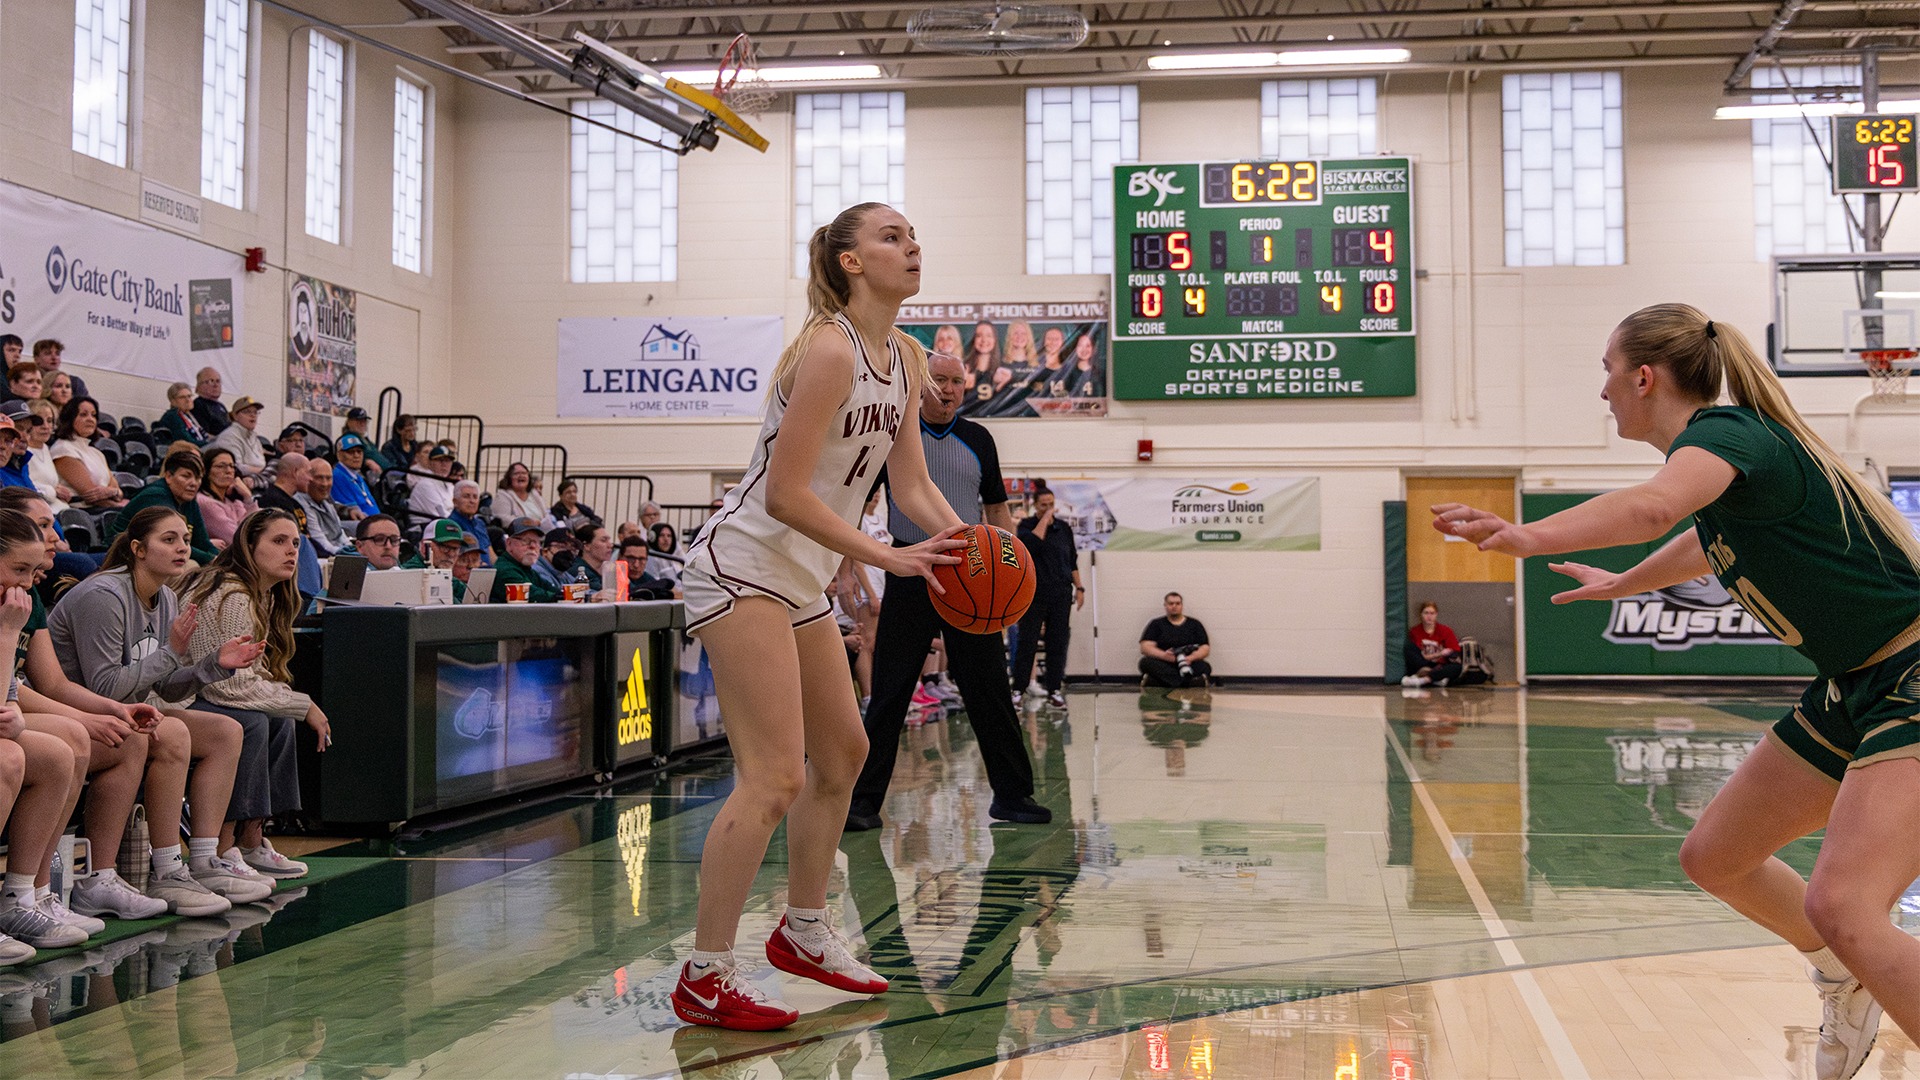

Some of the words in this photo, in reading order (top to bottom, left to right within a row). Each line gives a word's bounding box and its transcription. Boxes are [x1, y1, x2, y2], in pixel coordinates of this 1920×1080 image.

[1855, 119, 1913, 144] 6:22
[1867, 144, 1904, 186] 15
[1231, 163, 1316, 201] 6:22
[1323, 171, 1406, 184] BISMARCK
[145, 191, 174, 216] RESERVED
[175, 202, 199, 224] SEATING
[1333, 205, 1390, 223] GUEST
[1136, 210, 1185, 228] HOME
[1239, 218, 1282, 231] PERIOD
[1167, 231, 1192, 270] 5
[1263, 235, 1273, 263] 1
[1369, 229, 1394, 264] 4
[1128, 274, 1166, 287] FOULS
[1224, 272, 1269, 285] PLAYER
[1272, 271, 1301, 284] FOUL
[1359, 269, 1398, 282] FOULS
[70, 258, 108, 297] Gate
[110, 269, 143, 315] City
[144, 277, 183, 316] Bank
[1372, 281, 1395, 314] 0
[1141, 286, 1163, 318] 0
[1184, 287, 1206, 315] 4
[1320, 284, 1343, 312] 4
[900, 306, 944, 319] CKLE
[983, 304, 1043, 318] PHONE
[1048, 303, 1104, 317] DOWN
[87, 311, 99, 325] For
[107, 315, 128, 331] Better
[129, 321, 143, 338] Way
[1128, 322, 1166, 335] SCORE
[1242, 320, 1283, 333] MATCH
[1360, 318, 1399, 331] SCORE
[1189, 340, 1337, 364] SANFORD
[582, 367, 758, 394] LEINGANG
[1186, 367, 1341, 382] ORTHOPEDICS
[1165, 382, 1249, 395] SPORTS
[1256, 380, 1364, 394] MEDICINE
[630, 401, 662, 411] HOME
[665, 400, 709, 411] CENTER
[1171, 499, 1225, 513] Farmers
[1227, 499, 1264, 513] Union
[1171, 516, 1265, 525] INSURANCE
[618, 708, 652, 746] adidas
